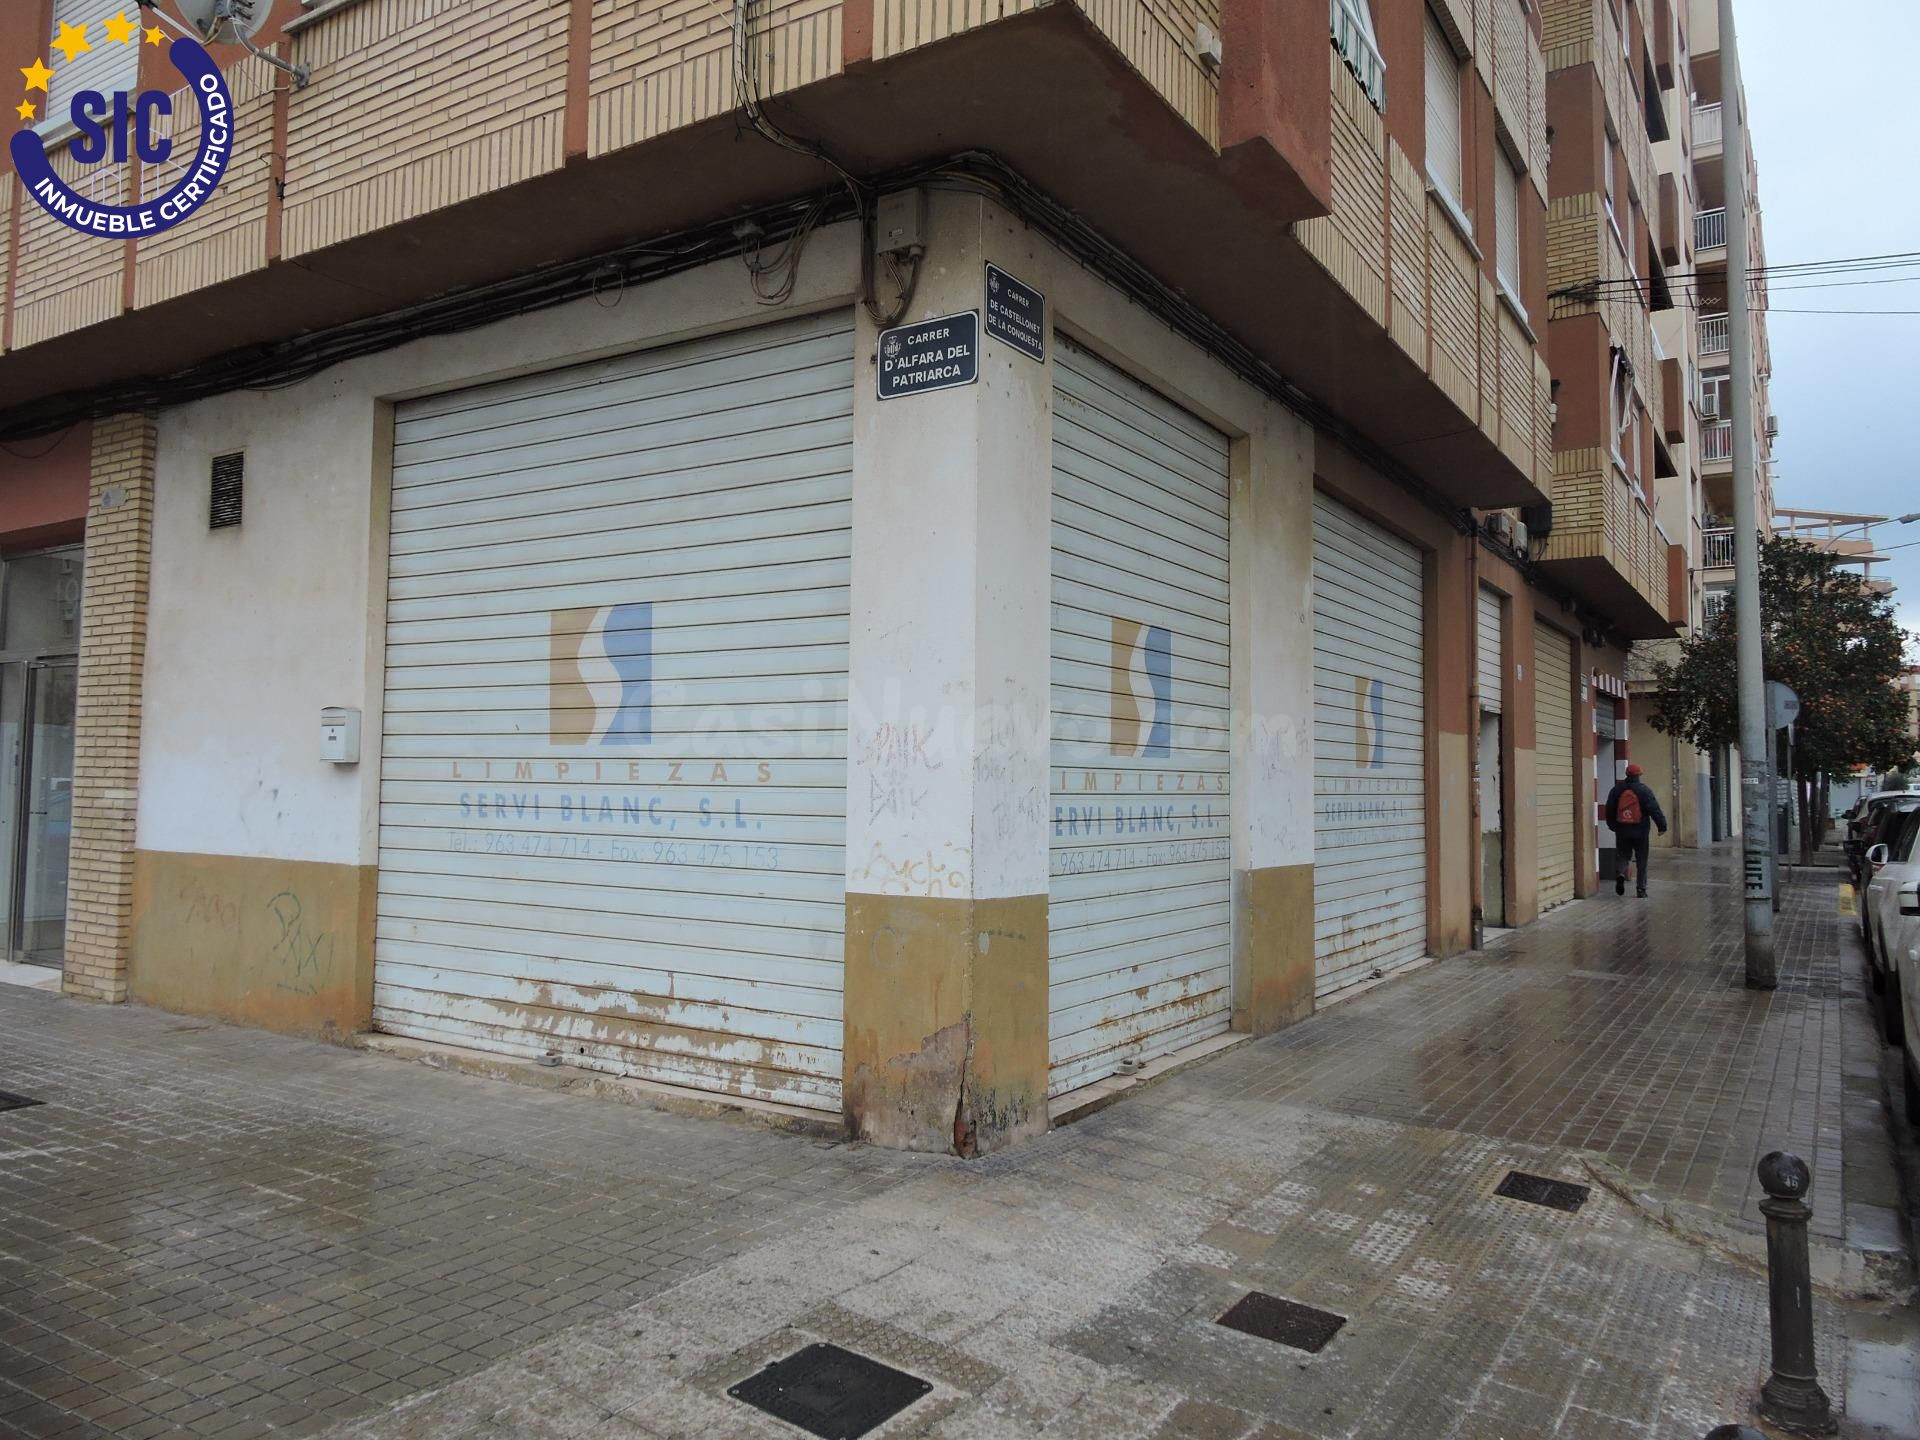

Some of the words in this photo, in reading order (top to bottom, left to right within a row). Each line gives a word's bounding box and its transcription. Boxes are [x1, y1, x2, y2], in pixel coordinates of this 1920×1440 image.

[1007, 288, 1030, 308] CARRER
[990, 298, 999, 312] DE
[1000, 303, 1041, 334] CASTELLONET
[907, 327, 950, 345] CARRER
[988, 313, 997, 326] DE
[998, 317, 1006, 331] LA
[1007, 322, 1043, 351] CONQUESTA
[884, 349, 944, 372] D'ALFARA
[947, 344, 970, 360] DEL
[892, 364, 961, 388] PATRIARCA
[452, 761, 771, 783] LIMPIEZAS
[1061, 771, 1224, 792] IMPIEZAS
[460, 792, 540, 821] SERVI
[699, 798, 762, 830] S.L.
[1055, 806, 1102, 837] ERVI
[1191, 803, 1220, 829] S.L.
[484, 832, 514, 854] 963
[522, 834, 550, 856] 474
[559, 836, 592, 857] 714
[654, 841, 688, 863] 963
[743, 845, 779, 871] 153
[1061, 852, 1085, 876] 963
[1089, 850, 1111, 872] 474
[1115, 847, 1135, 869] 714
